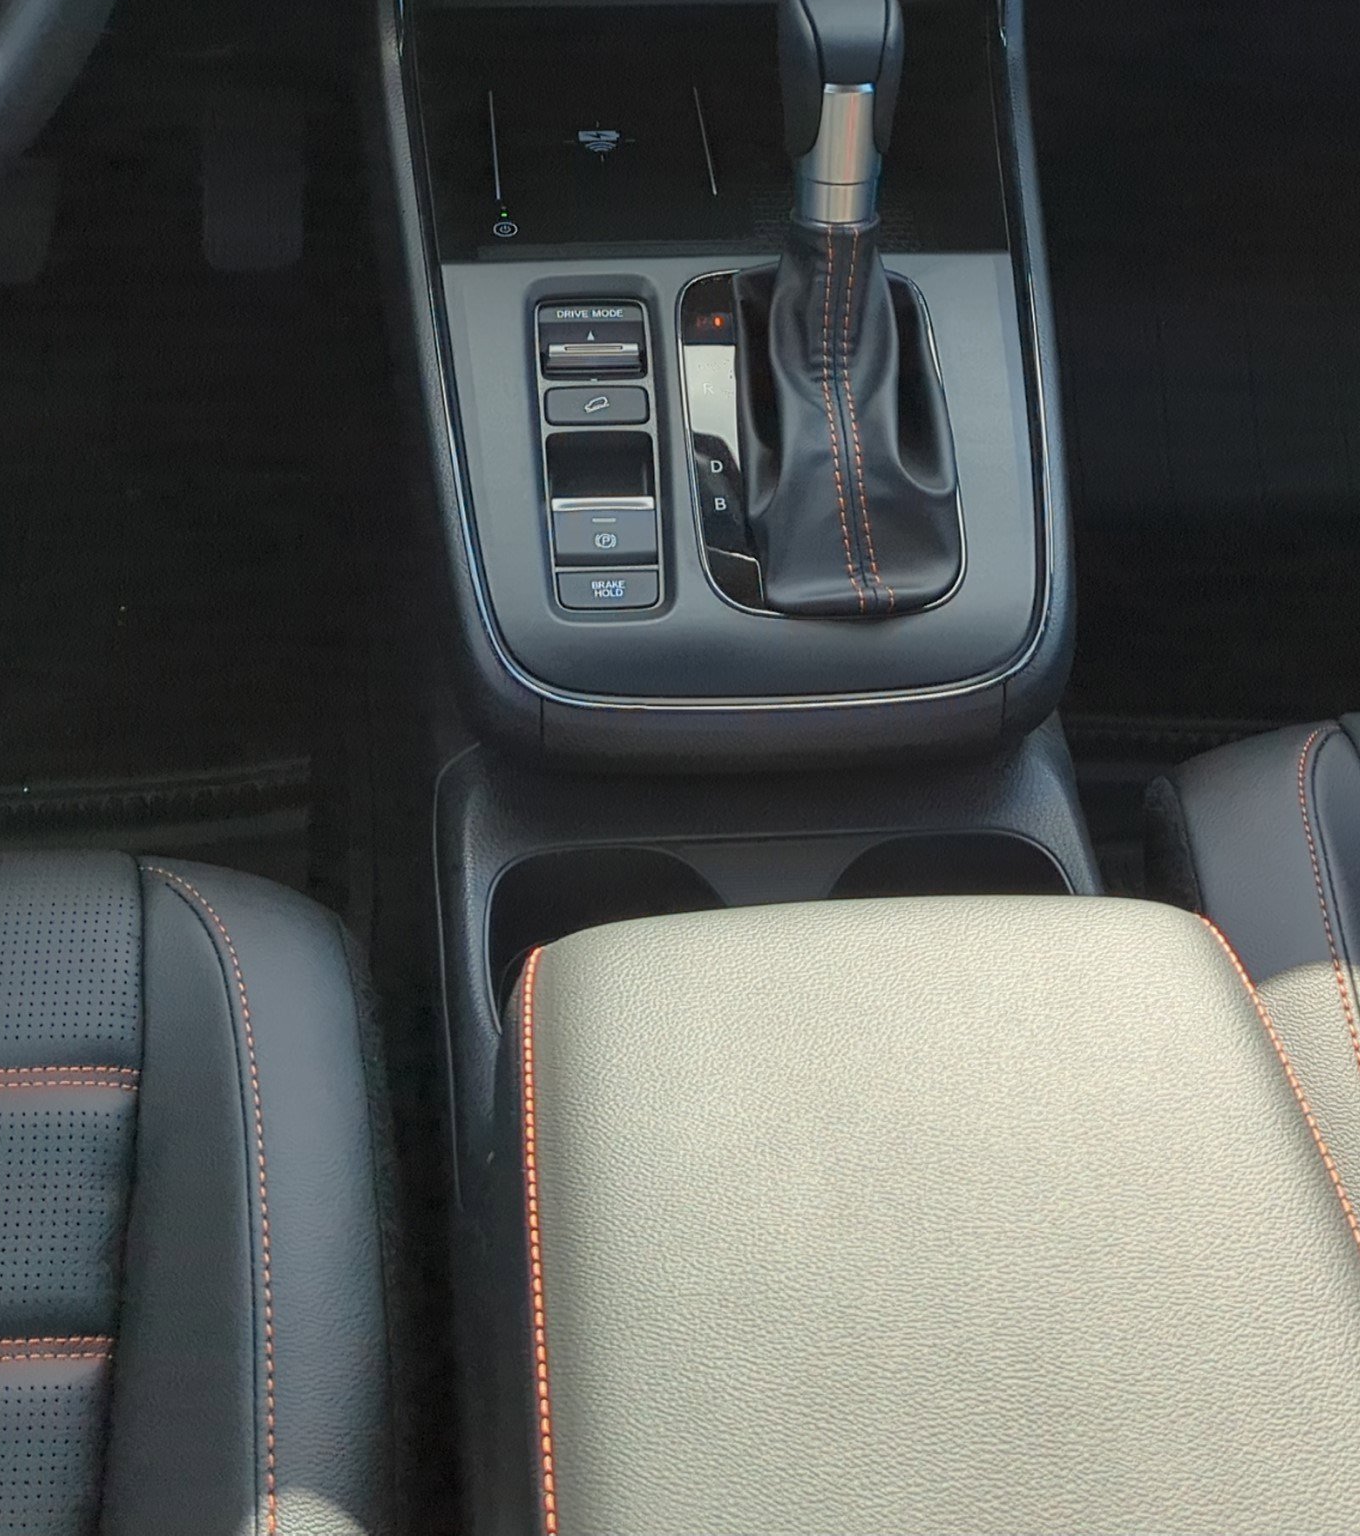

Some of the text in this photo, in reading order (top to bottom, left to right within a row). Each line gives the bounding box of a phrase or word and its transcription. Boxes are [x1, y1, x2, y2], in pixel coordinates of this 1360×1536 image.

[556, 308, 624, 319] DRIVE MODE
[702, 381, 714, 395] R
[710, 459, 723, 474] D
[714, 497, 727, 511] B
[591, 580, 626, 590] BRAKE
[594, 588, 624, 598] HOLD
